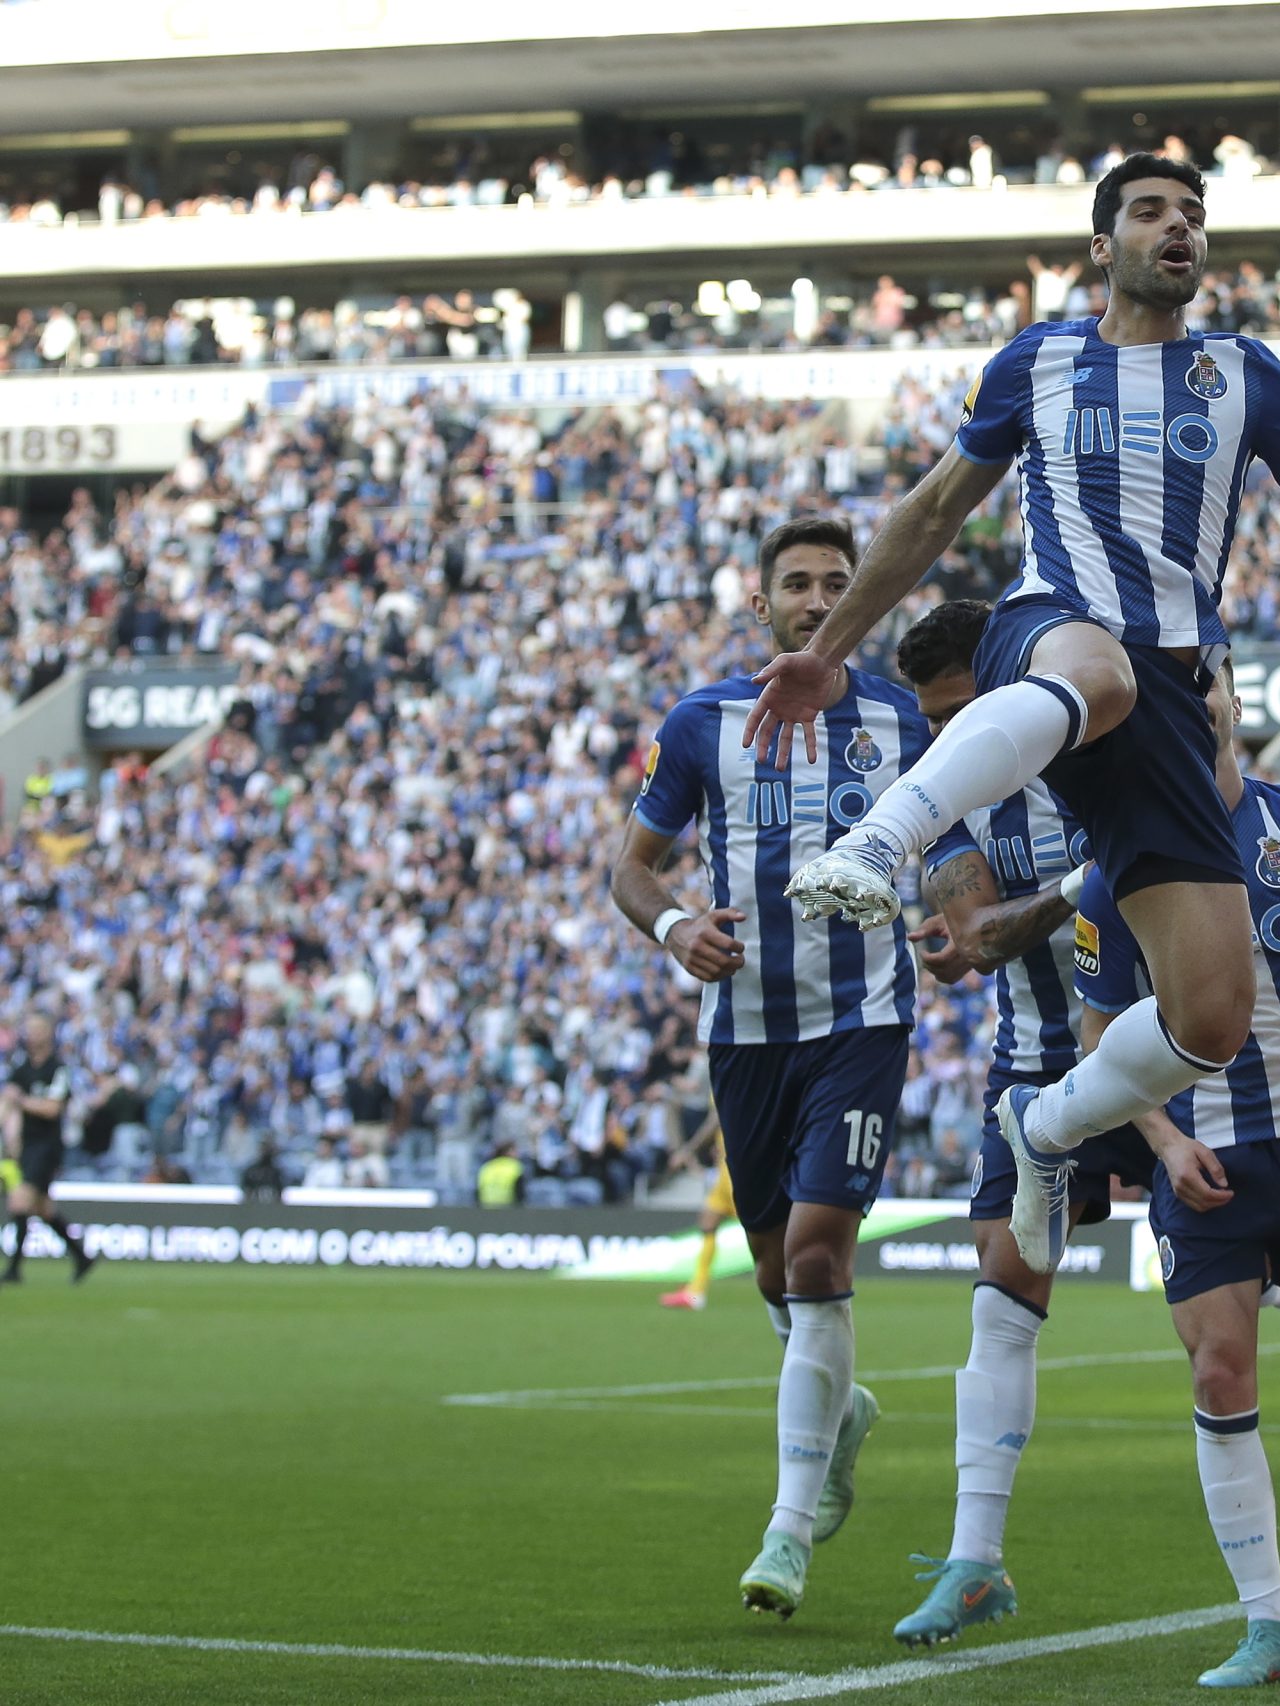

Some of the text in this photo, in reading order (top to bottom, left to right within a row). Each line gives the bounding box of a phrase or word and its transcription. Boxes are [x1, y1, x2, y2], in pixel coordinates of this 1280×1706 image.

[0, 424, 117, 463] 1893
[1062, 407, 1219, 463] MEO
[745, 781, 875, 827] MEO
[843, 1109, 883, 1170] 16
[83, 1223, 150, 1260] POR
[151, 1225, 241, 1263] LITRO
[241, 1227, 319, 1265] COM
[319, 1228, 349, 1266] O
[349, 1226, 475, 1268] CARTÃO
[476, 1232, 586, 1270] POUPA
